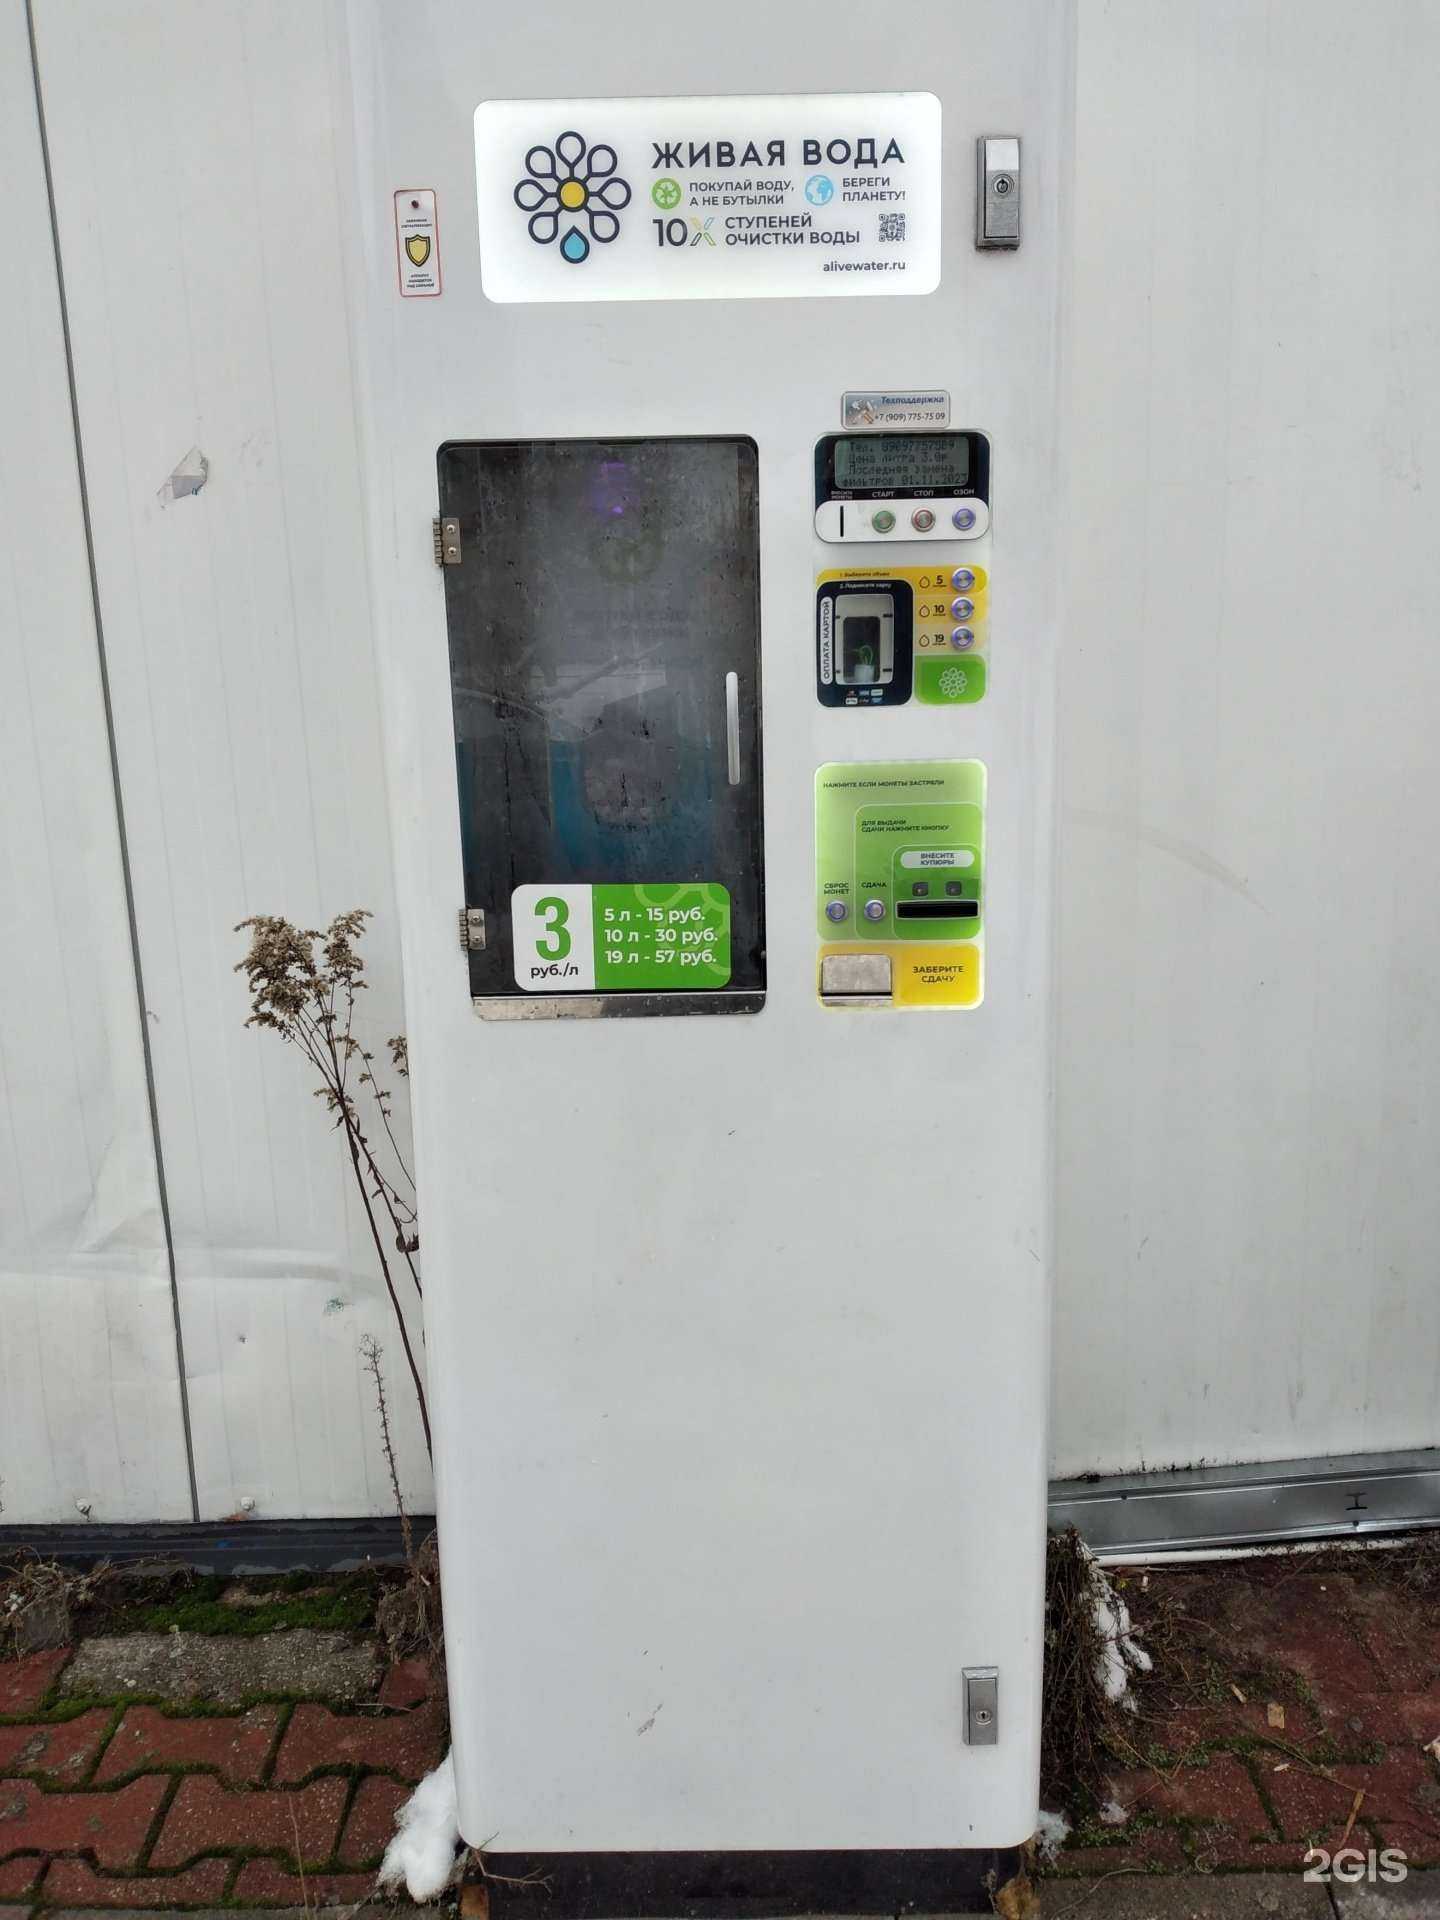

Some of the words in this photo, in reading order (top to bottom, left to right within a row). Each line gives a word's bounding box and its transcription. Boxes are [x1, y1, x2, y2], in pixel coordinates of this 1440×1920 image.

[651, 140, 785, 168] ЖИВАЯ
[802, 138, 906, 169] ВОДА
[689, 179, 754, 192] ПОКУПАЙ
[756, 180, 796, 194] ВОДУ,
[842, 176, 891, 188] БЕРЕГИ
[689, 197, 699, 207] А
[702, 197, 719, 207] НЕ
[722, 193, 785, 206] БУТЫЛКИ
[842, 190, 906, 203] ПЛАНЕТУ!
[725, 211, 813, 229] СТУПЕНЕЙ
[725, 230, 805, 247] ОЧИСТКИ
[809, 230, 861, 246] ВОДЫ
[823, 258, 906, 273] alivewater.ru
[881, 396, 944, 406] Техподдержка
[886, 412, 906, 424] (909)
[908, 412, 934, 422] 775-75
[935, 411, 946, 421] 09
[848, 453, 875, 465] Цена
[848, 465, 909, 477] Последняя
[915, 464, 955, 474] замена
[872, 490, 896, 498] СТАРТ
[913, 489, 934, 497] СТОП
[953, 488, 975, 496] ОЗОН
[935, 575, 943, 585] 5
[934, 604, 945, 614] 10
[823, 600, 831, 638] КАРТОЙ
[934, 634, 945, 644] 19
[823, 642, 831, 680] ОПЛАТА
[858, 780, 877, 788] ЕСЛИ
[862, 819, 875, 827] ДЛЯ
[877, 818, 906, 826] ВЫДАЧИ
[604, 908, 615, 922] 5
[619, 910, 631, 922] л
[646, 908, 664, 920] 15
[668, 907, 706, 924] руб.
[534, 896, 572, 962] 3
[604, 929, 622, 943] 10
[627, 930, 640, 943] л
[655, 928, 677, 942] 30
[681, 928, 719, 945] руб.
[605, 950, 623, 964] 19
[626, 952, 640, 963] л
[655, 950, 676, 963] 57
[680, 949, 718, 966] руб.
[530, 963, 579, 979] руб./л
[913, 965, 965, 974] ЗАБЕРИТЕ
[921, 974, 956, 983] СДАЧУ
